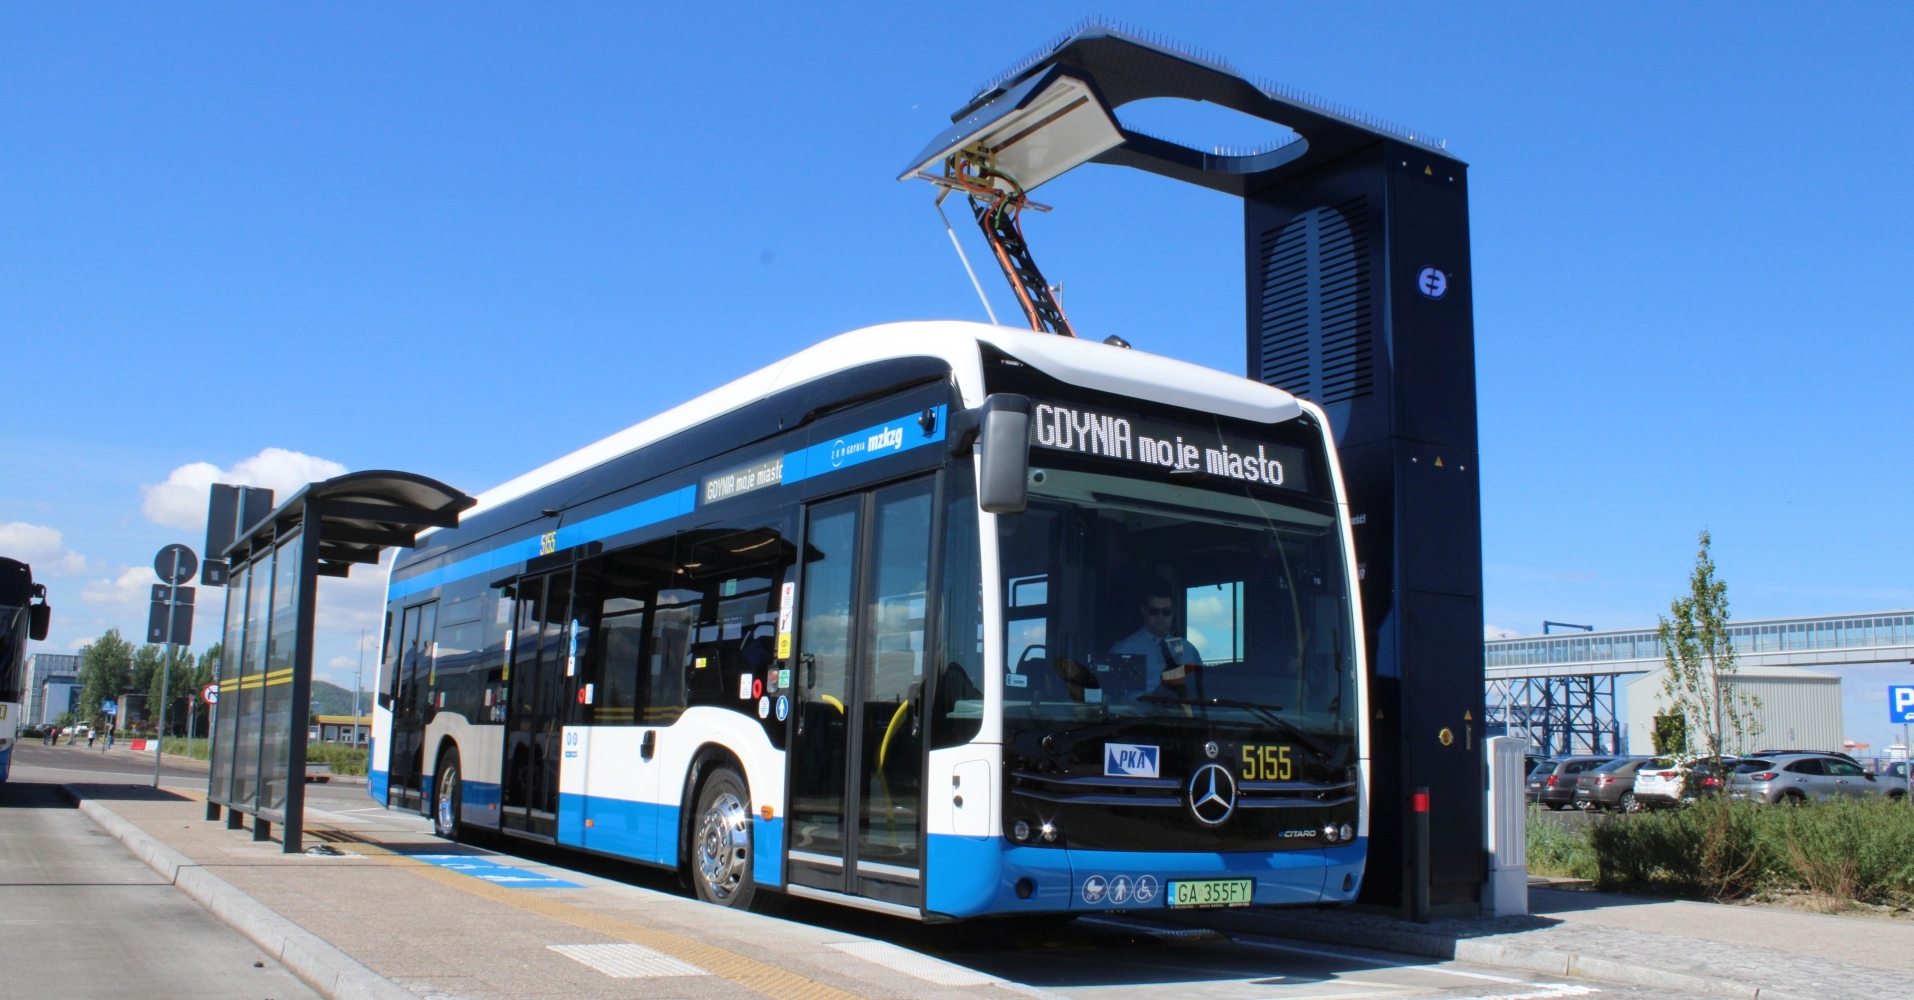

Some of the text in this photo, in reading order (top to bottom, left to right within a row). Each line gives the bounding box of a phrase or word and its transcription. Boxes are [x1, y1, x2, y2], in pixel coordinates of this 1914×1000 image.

[867, 426, 904, 453] mzkzg
[1036, 403, 1284, 486] GDYNIA moje miasto
[707, 474, 735, 500] GDYNIA
[736, 469, 755, 492] moje
[540, 531, 557, 556] 5155
[1895, 687, 1914, 713] P
[1119, 749, 1146, 769] PKA
[1242, 744, 1292, 780] 5155
[1178, 881, 1249, 903] GA 355FY
